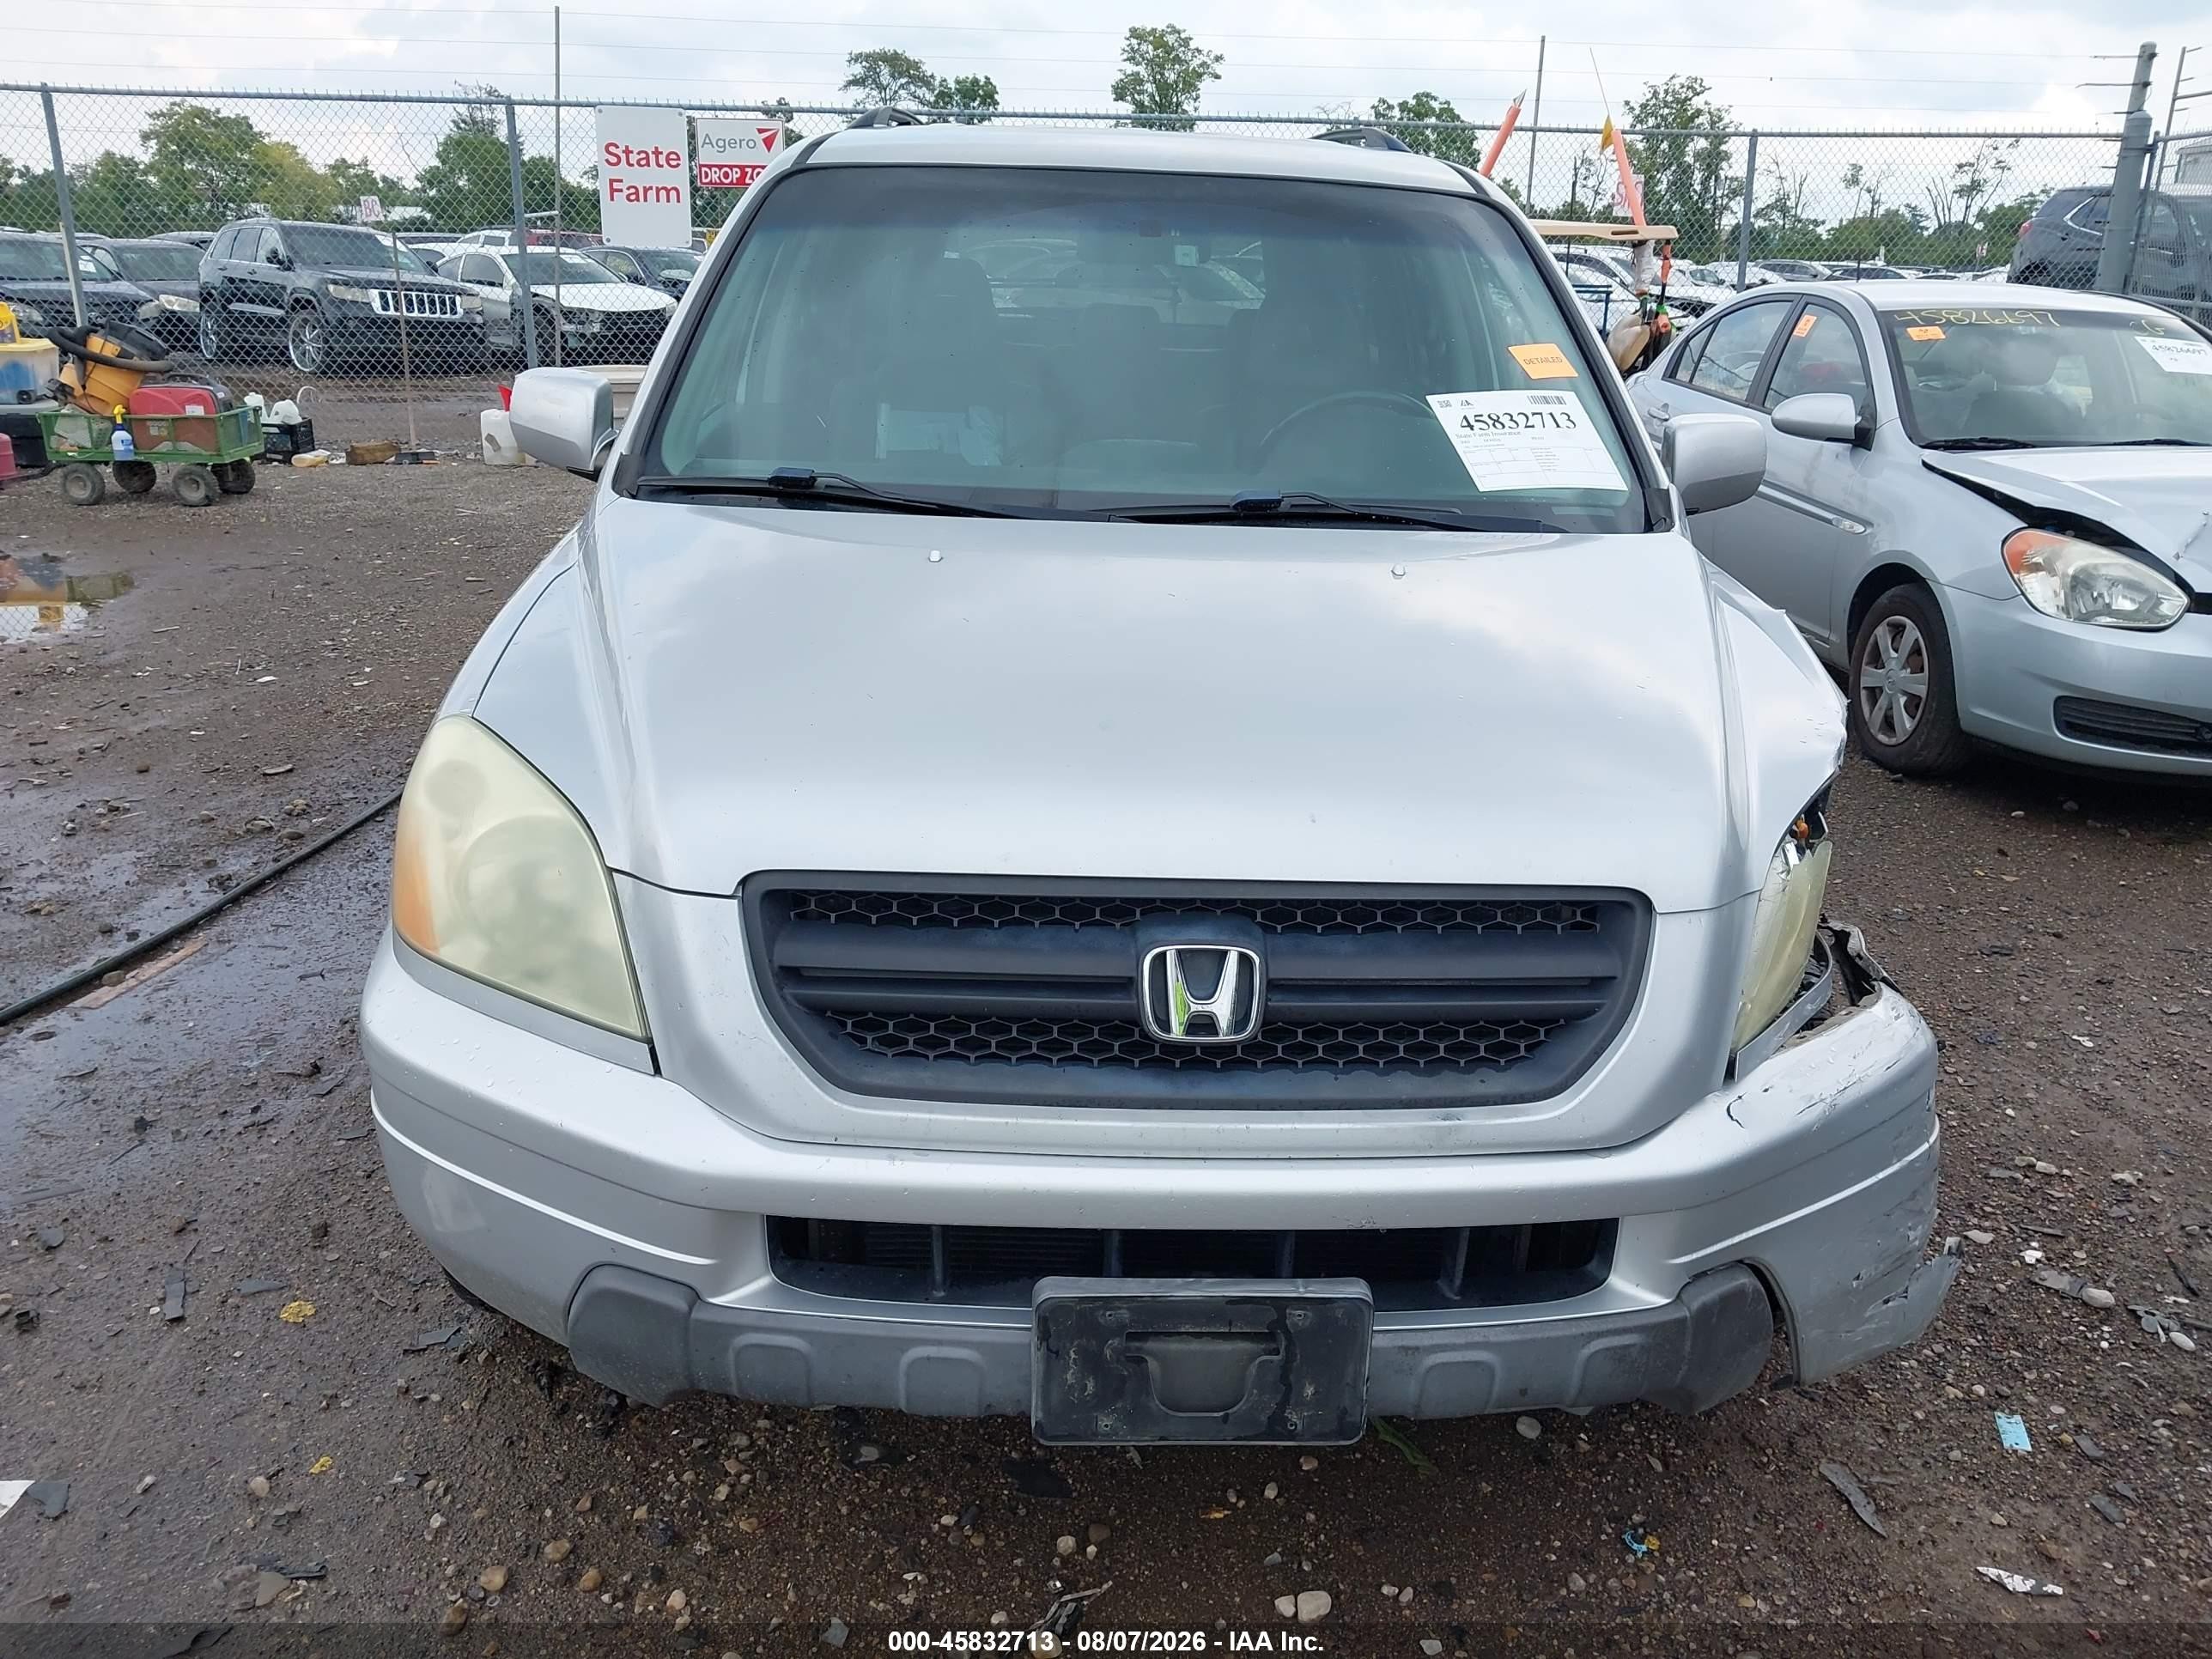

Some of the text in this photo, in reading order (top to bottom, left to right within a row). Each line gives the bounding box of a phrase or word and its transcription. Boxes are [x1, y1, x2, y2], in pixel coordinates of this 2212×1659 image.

[701, 133, 757, 154] Agero
[604, 142, 682, 169] State
[701, 167, 741, 184] DROP
[608, 178, 681, 204] Farm
[1894, 309, 2061, 327] 45826697
[1523, 356, 1563, 365] DETAILED
[1460, 411, 1577, 431] 45832713
